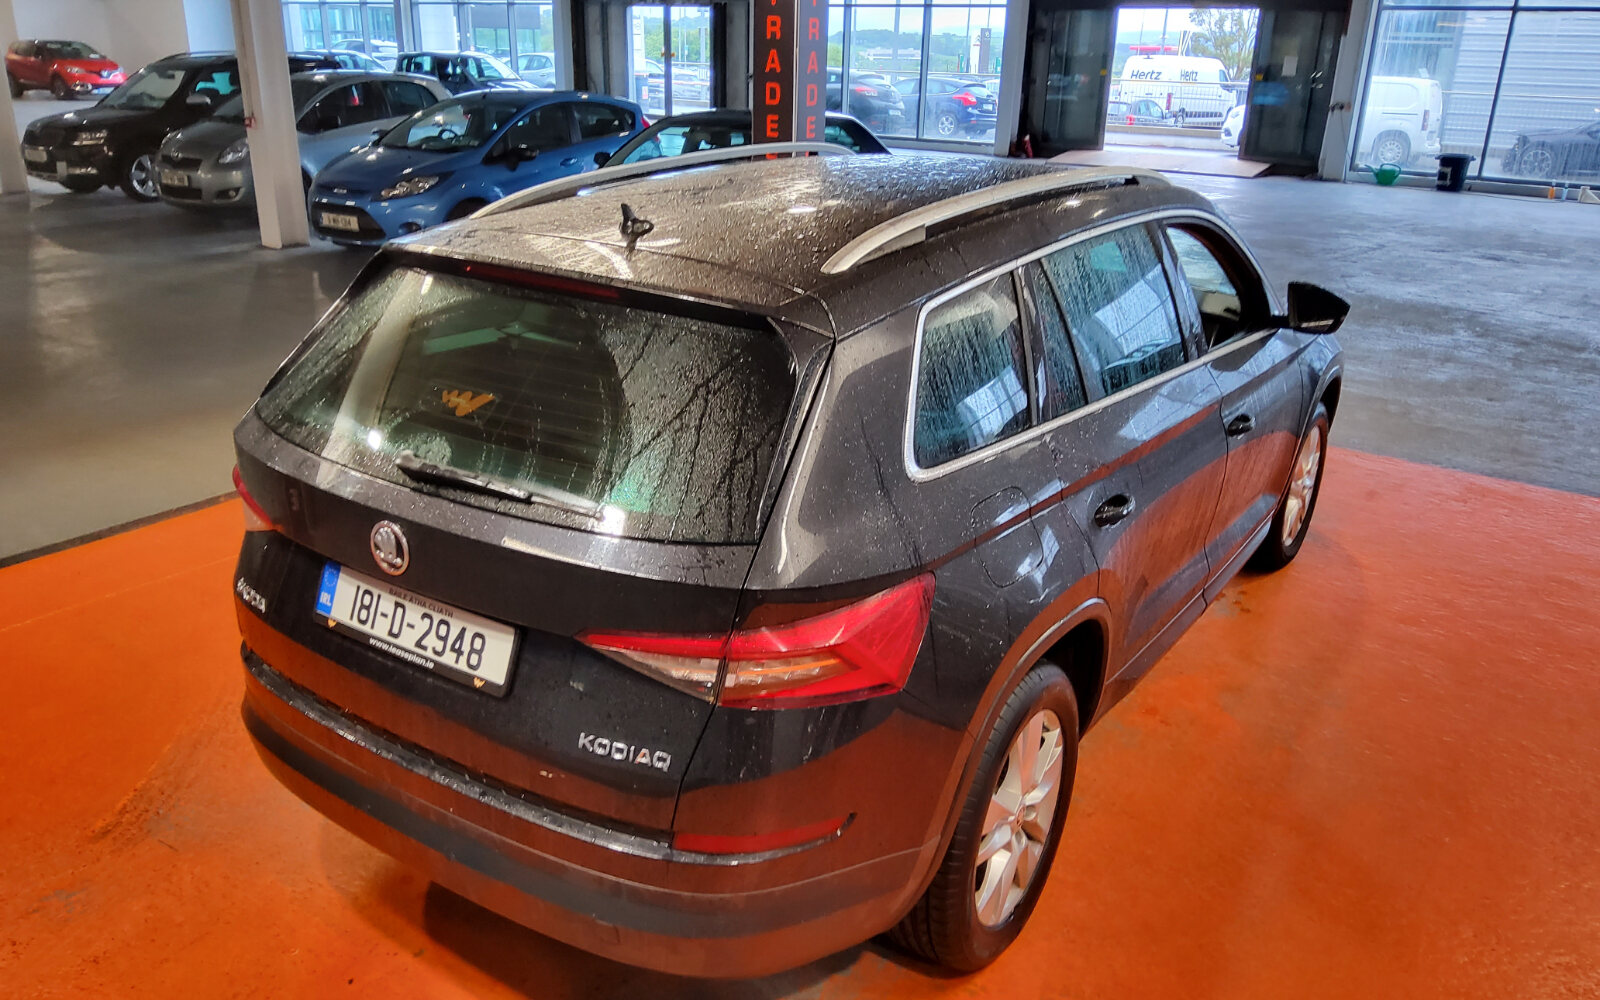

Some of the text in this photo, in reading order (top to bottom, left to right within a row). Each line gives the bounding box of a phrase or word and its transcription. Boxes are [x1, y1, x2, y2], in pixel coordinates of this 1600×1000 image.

[1130, 69, 1162, 80] Hertz
[1180, 69, 1199, 82] Hertz
[319, 591, 332, 607] IRL
[349, 585, 486, 671] 181-D-2948
[369, 637, 435, 670] www.leaseplan.ie
[578, 732, 672, 772] KODIAQ
